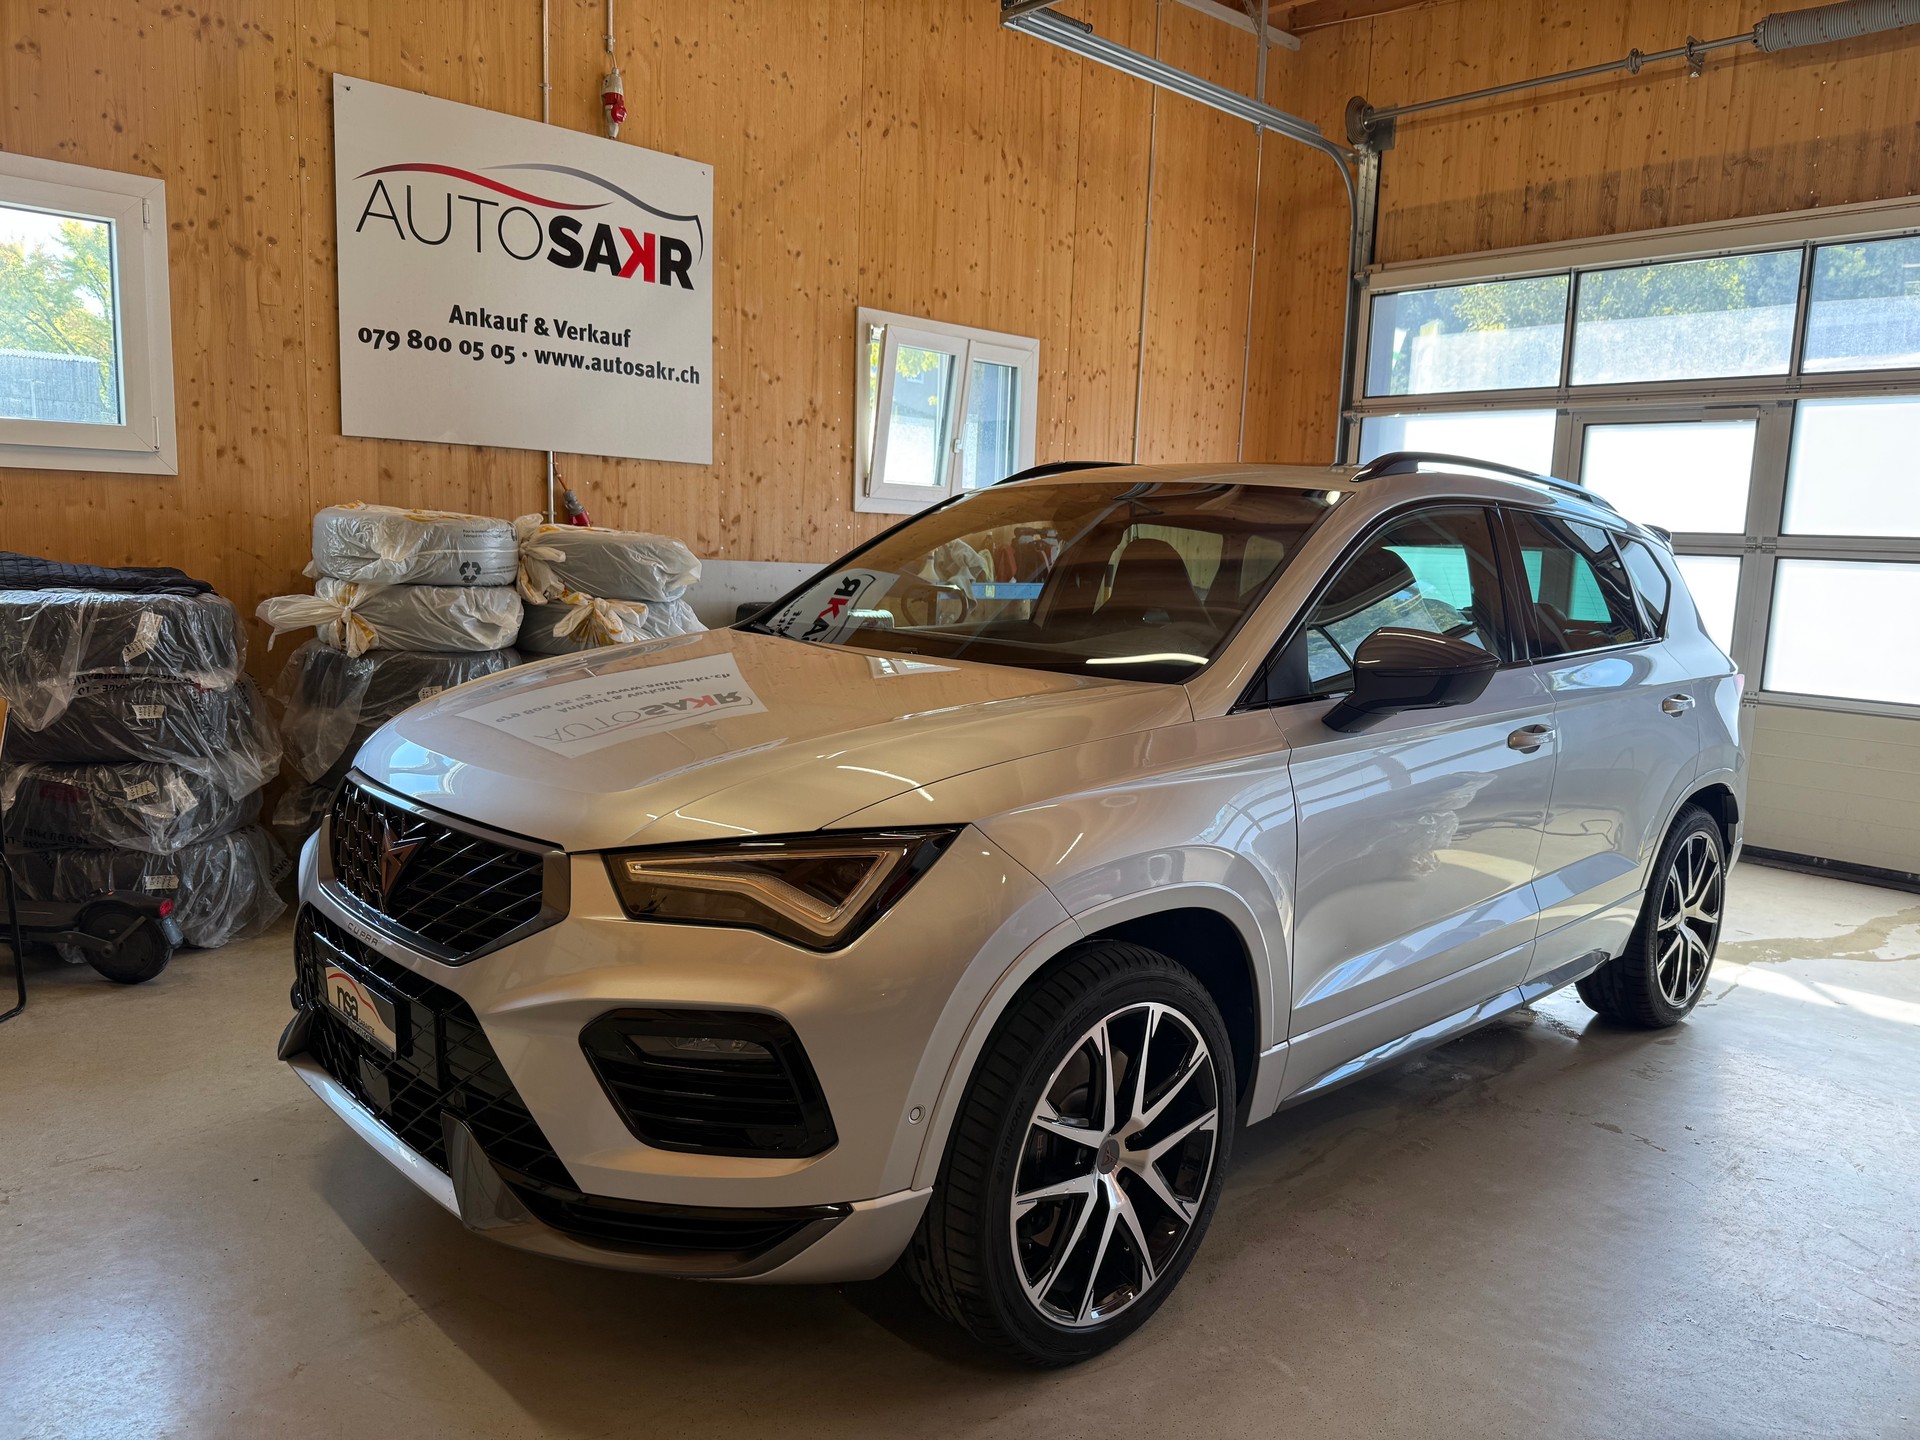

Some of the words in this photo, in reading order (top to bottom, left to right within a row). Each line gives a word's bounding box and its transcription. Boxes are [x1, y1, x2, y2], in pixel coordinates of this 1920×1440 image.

[355, 179, 695, 290] AUTOSAKR
[448, 304, 528, 333] Ankauf
[533, 317, 550, 337] &
[552, 318, 632, 348] Verkauf
[357, 327, 401, 352] 079
[406, 329, 453, 354] 800
[458, 339, 485, 361] 05
[490, 343, 517, 365] 05
[533, 348, 700, 386] www.autosakr.ch
[347, 922, 379, 947] CUPRA
[336, 985, 359, 1023] nsa
